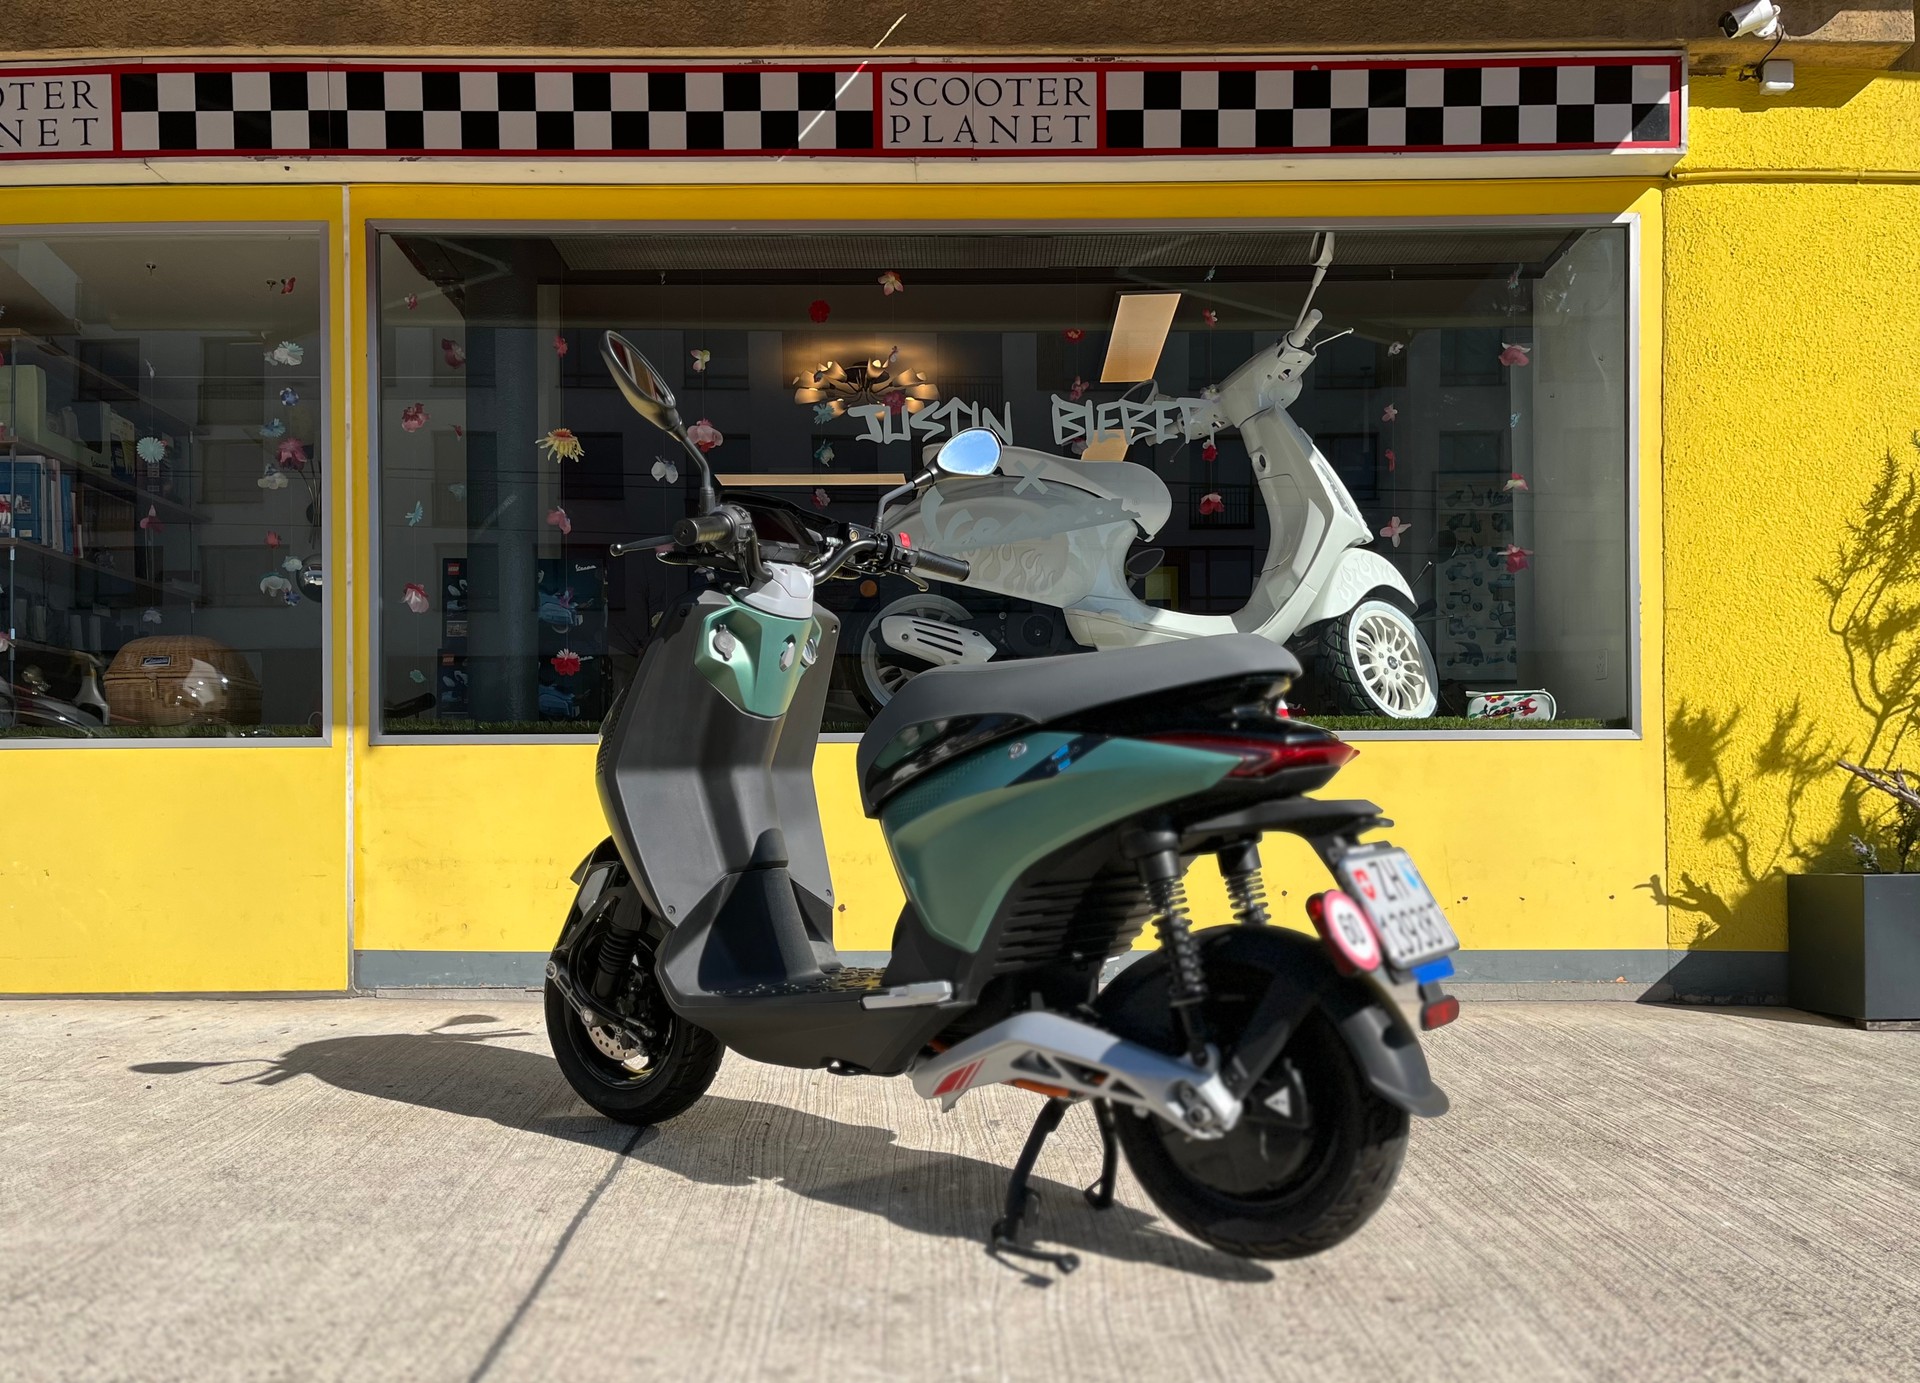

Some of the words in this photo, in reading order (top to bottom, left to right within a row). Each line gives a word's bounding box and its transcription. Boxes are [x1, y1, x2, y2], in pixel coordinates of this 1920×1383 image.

[0, 80, 99, 111] TER
[888, 77, 1091, 107] SCOOTER
[889, 115, 1091, 144] PLANET
[847, 396, 1014, 446] JUSTIN
[1367, 857, 1411, 900] ZH
[1337, 912, 1367, 945] 60
